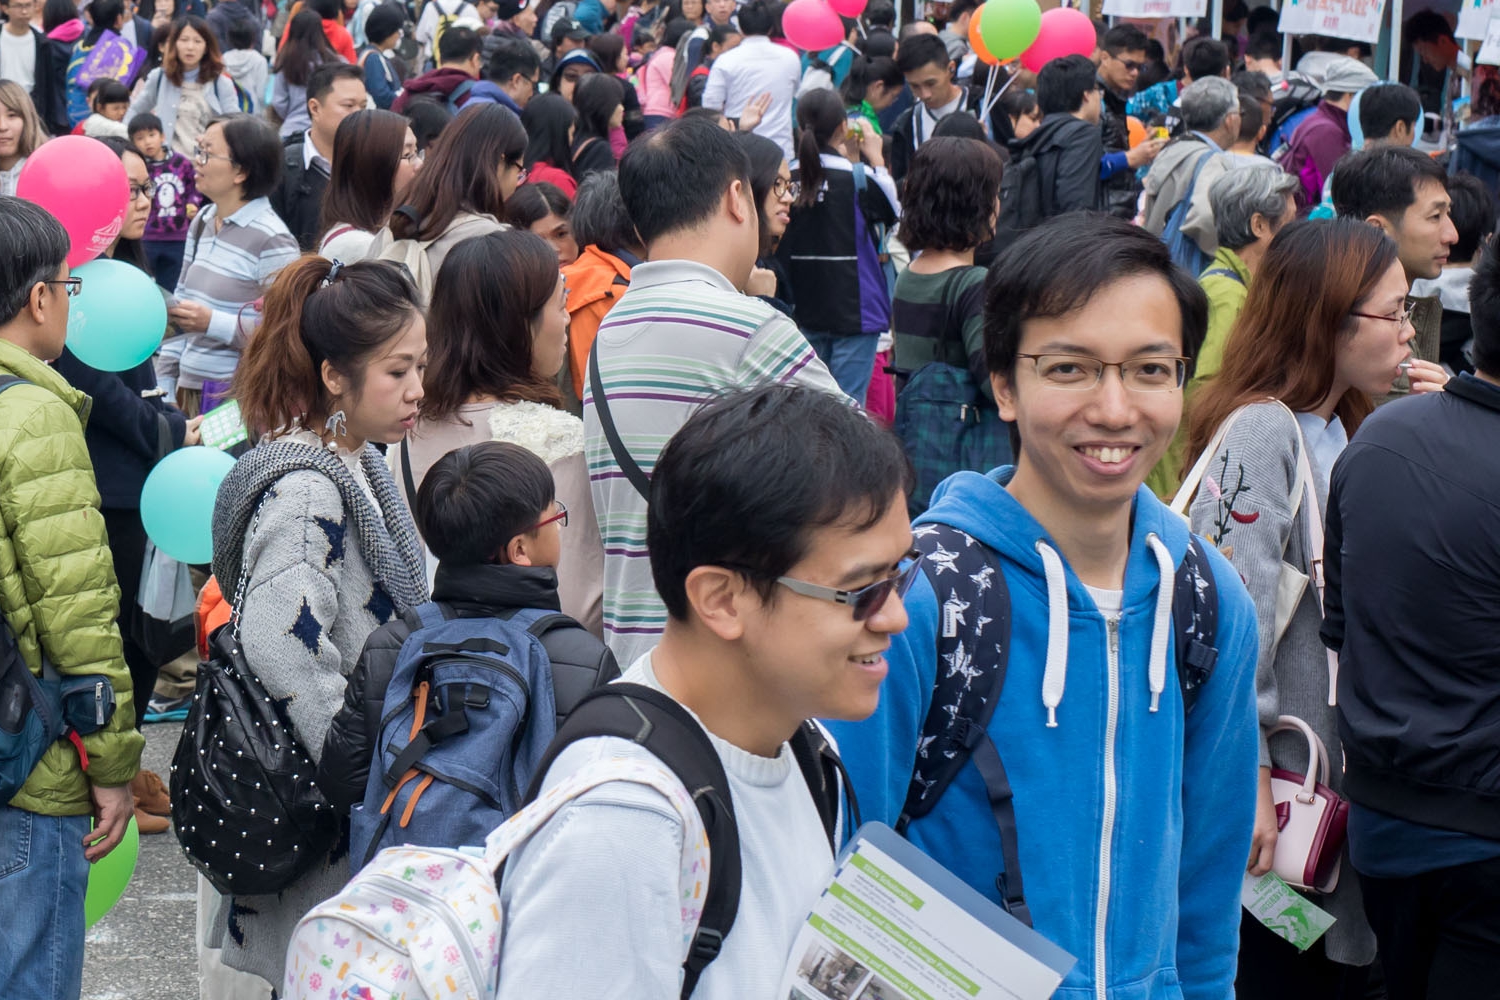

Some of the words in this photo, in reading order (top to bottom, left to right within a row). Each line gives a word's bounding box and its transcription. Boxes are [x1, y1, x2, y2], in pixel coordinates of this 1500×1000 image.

[878, 874, 915, 904] Scholarship
[840, 892, 872, 917] Internship
[870, 914, 885, 927] and
[883, 923, 909, 943] Student
[906, 940, 937, 965] Exchange
[934, 961, 972, 990] Programme
[841, 939, 871, 962] Teaching
[868, 957, 883, 970] and
